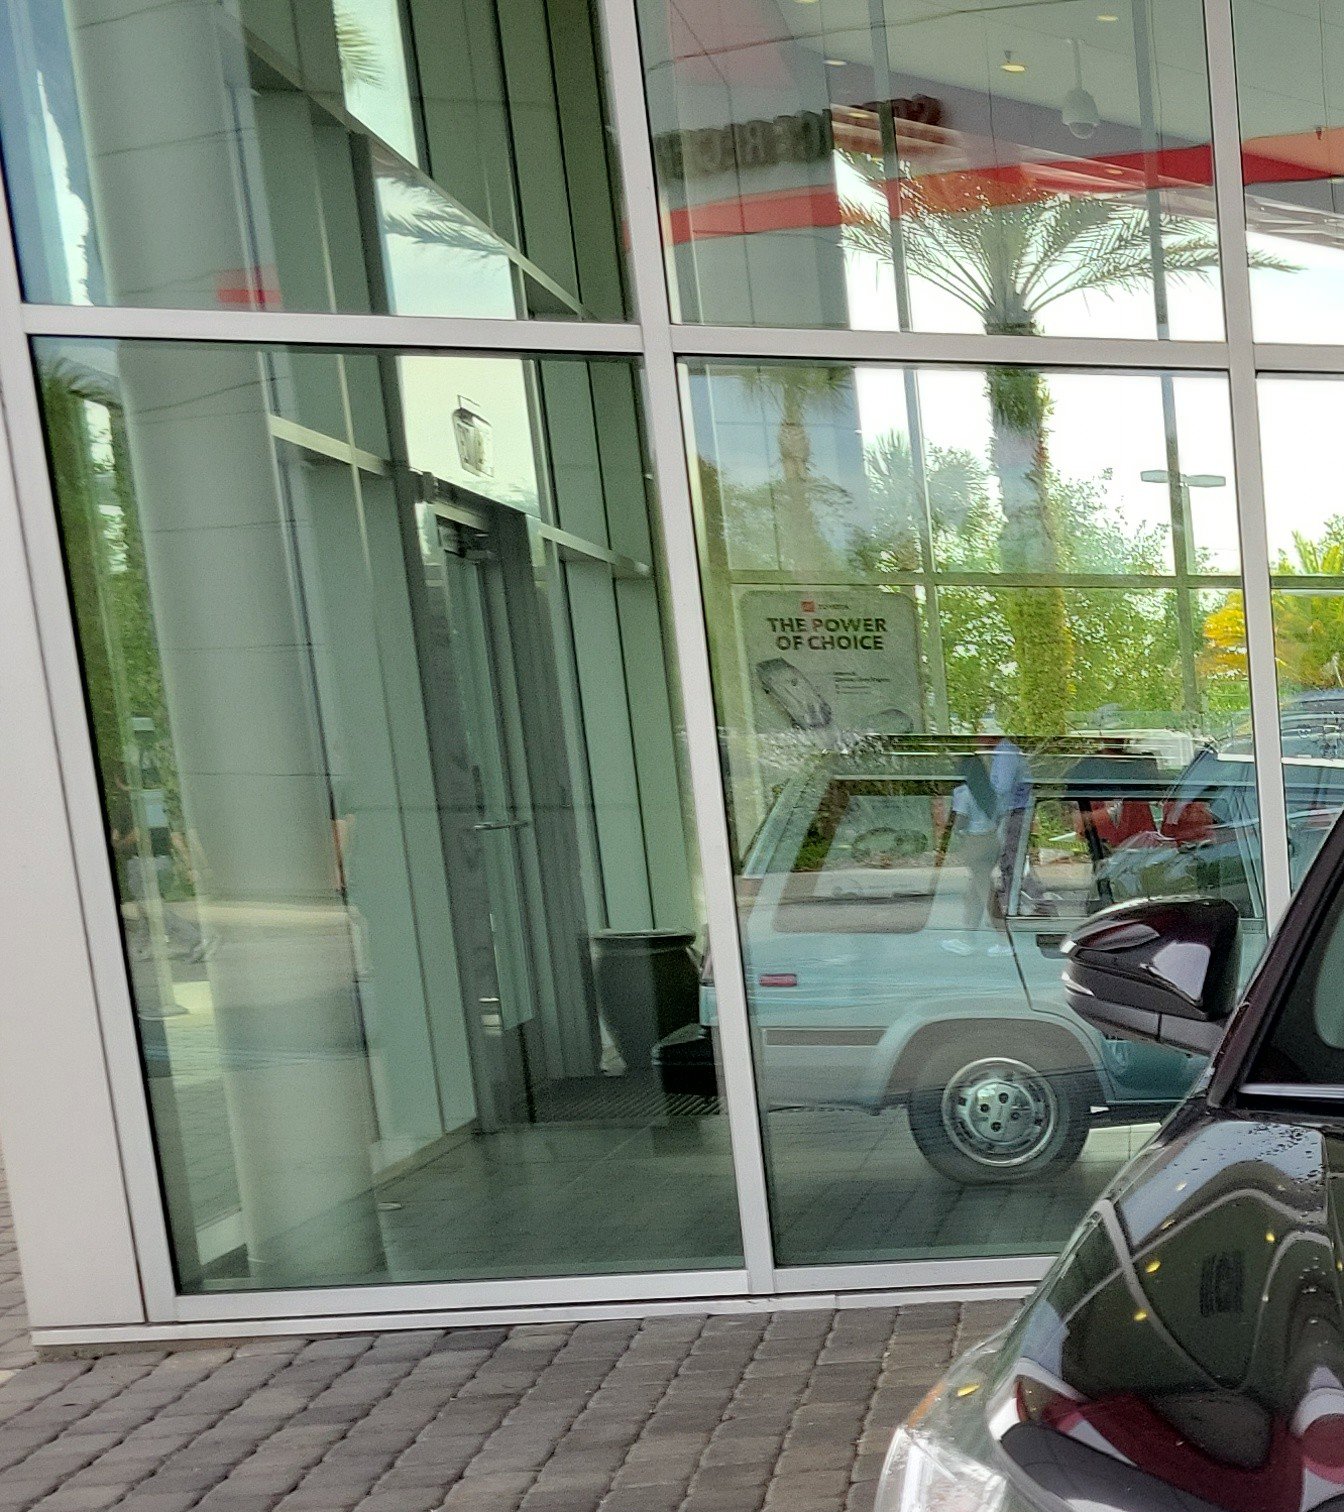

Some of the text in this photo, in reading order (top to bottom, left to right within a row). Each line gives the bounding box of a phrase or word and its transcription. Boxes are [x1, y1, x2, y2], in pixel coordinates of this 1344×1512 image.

[767, 617, 887, 632] THE POWER
[777, 635, 884, 650] OF CHOICE
